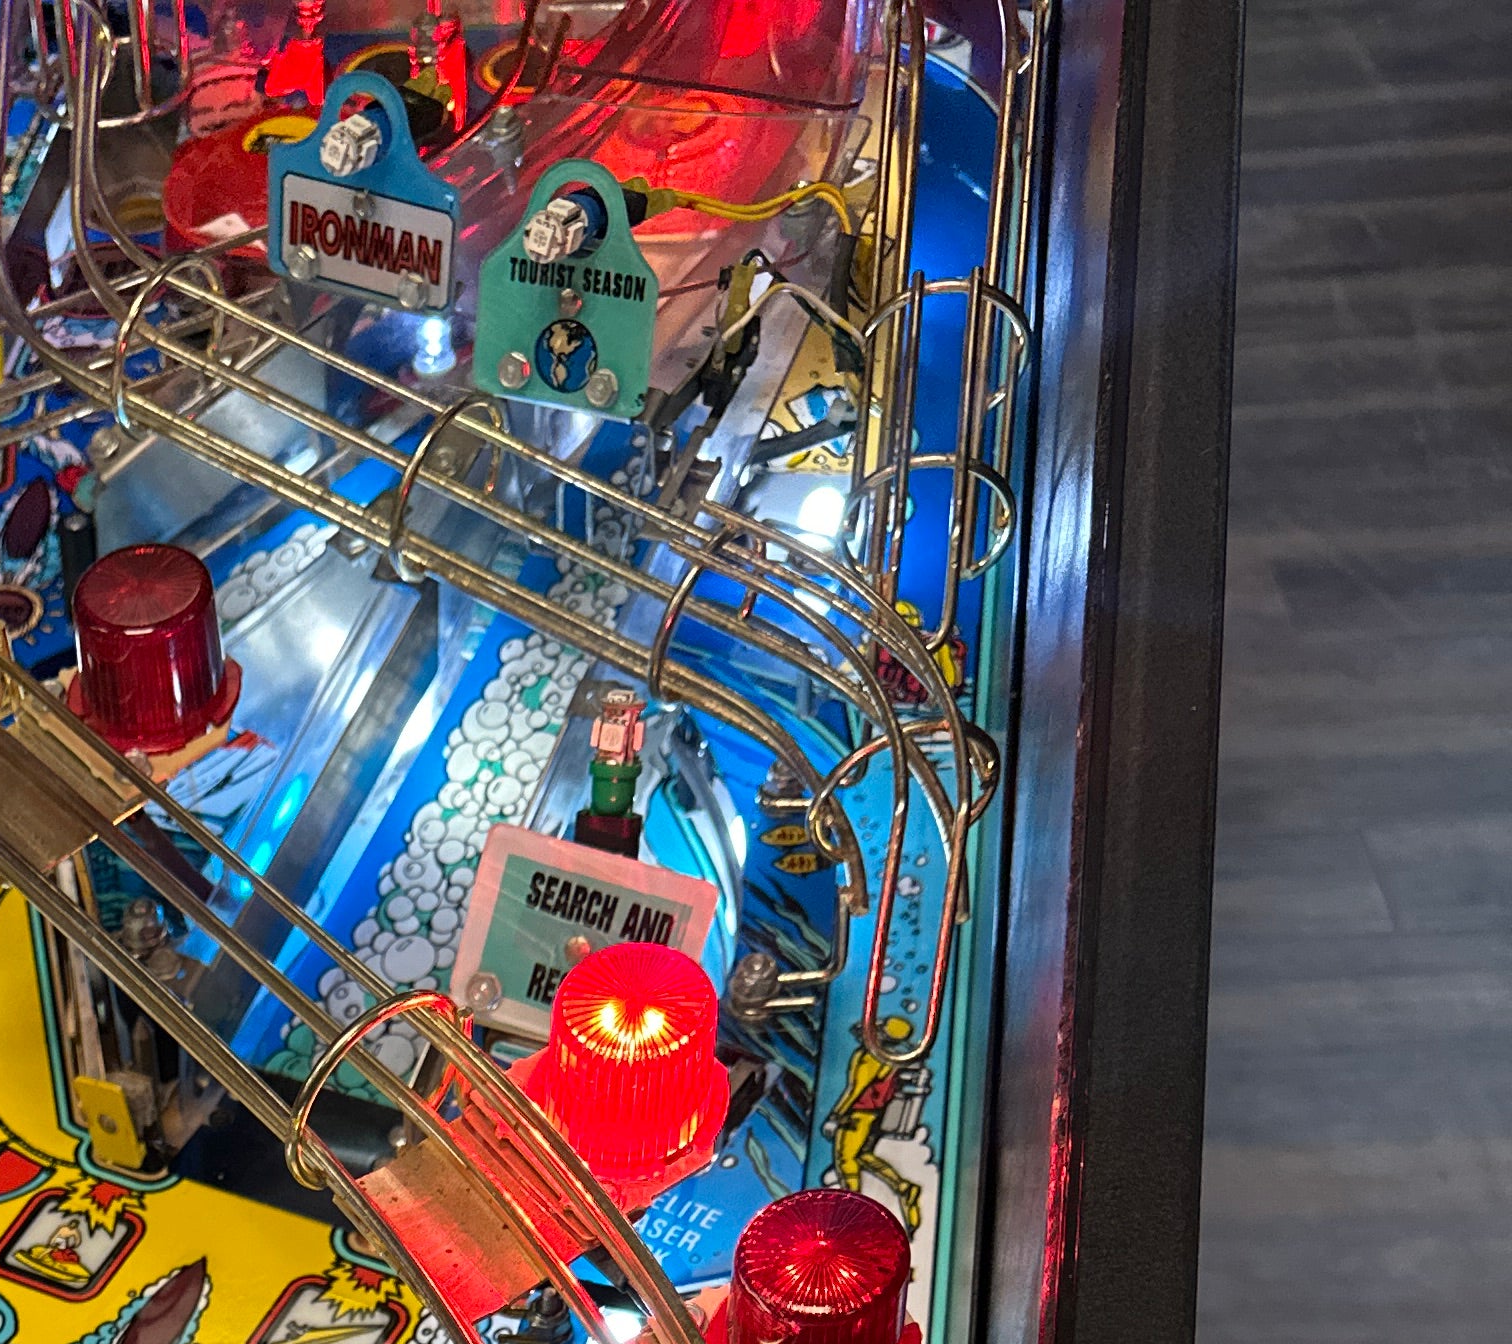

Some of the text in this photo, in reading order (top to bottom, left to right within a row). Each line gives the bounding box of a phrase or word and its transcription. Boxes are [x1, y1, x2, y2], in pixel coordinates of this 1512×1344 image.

[290, 201, 443, 286] IRONMAN
[510, 257, 647, 302] TOURIST SEASON
[526, 871, 675, 946] SEARCH AND
